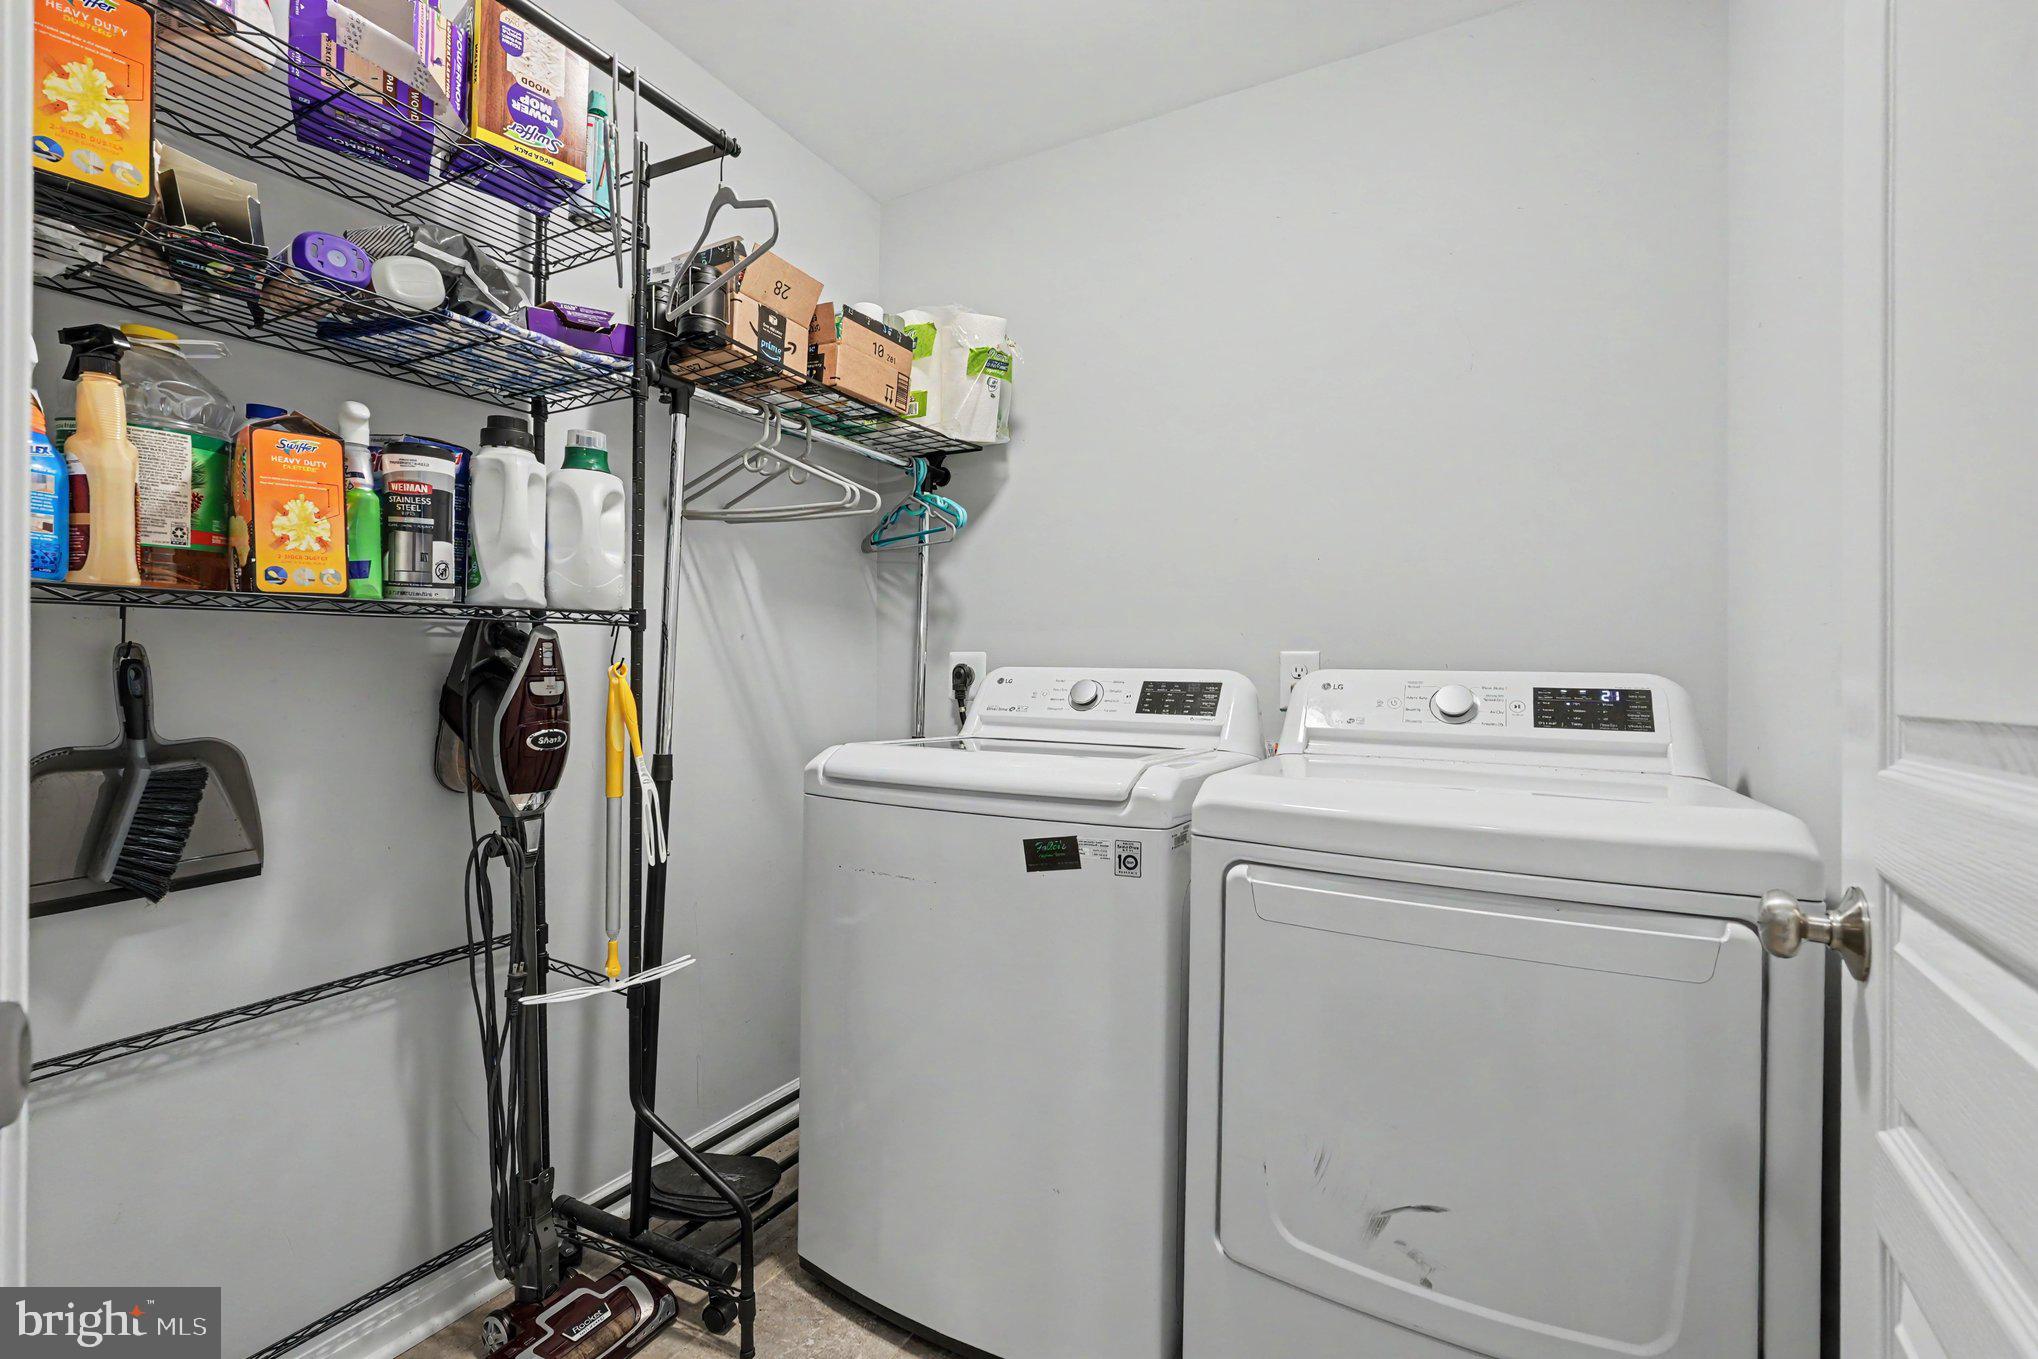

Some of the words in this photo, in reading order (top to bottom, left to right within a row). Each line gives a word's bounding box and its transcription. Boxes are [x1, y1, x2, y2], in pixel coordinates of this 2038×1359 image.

[45, 0, 89, 21] HEAVY
[94, 17, 128, 38] DUTY
[386, 74, 394, 92] PAD
[520, 76, 551, 97] WOOD
[511, 99, 559, 128] POWER
[519, 94, 552, 115] MOP
[508, 122, 564, 154] Swiffer
[773, 280, 791, 300] 28
[872, 341, 884, 358] 10
[276, 438, 319, 454] Swiffer
[271, 455, 300, 465] HEAVY
[303, 459, 328, 468] DUTY
[390, 482, 429, 493] WEIMAN
[388, 495, 432, 505] STAINLESS
[396, 504, 422, 512] STEEL
[538, 735, 562, 745] Shark
[572, 1309, 604, 1334] Rocket
